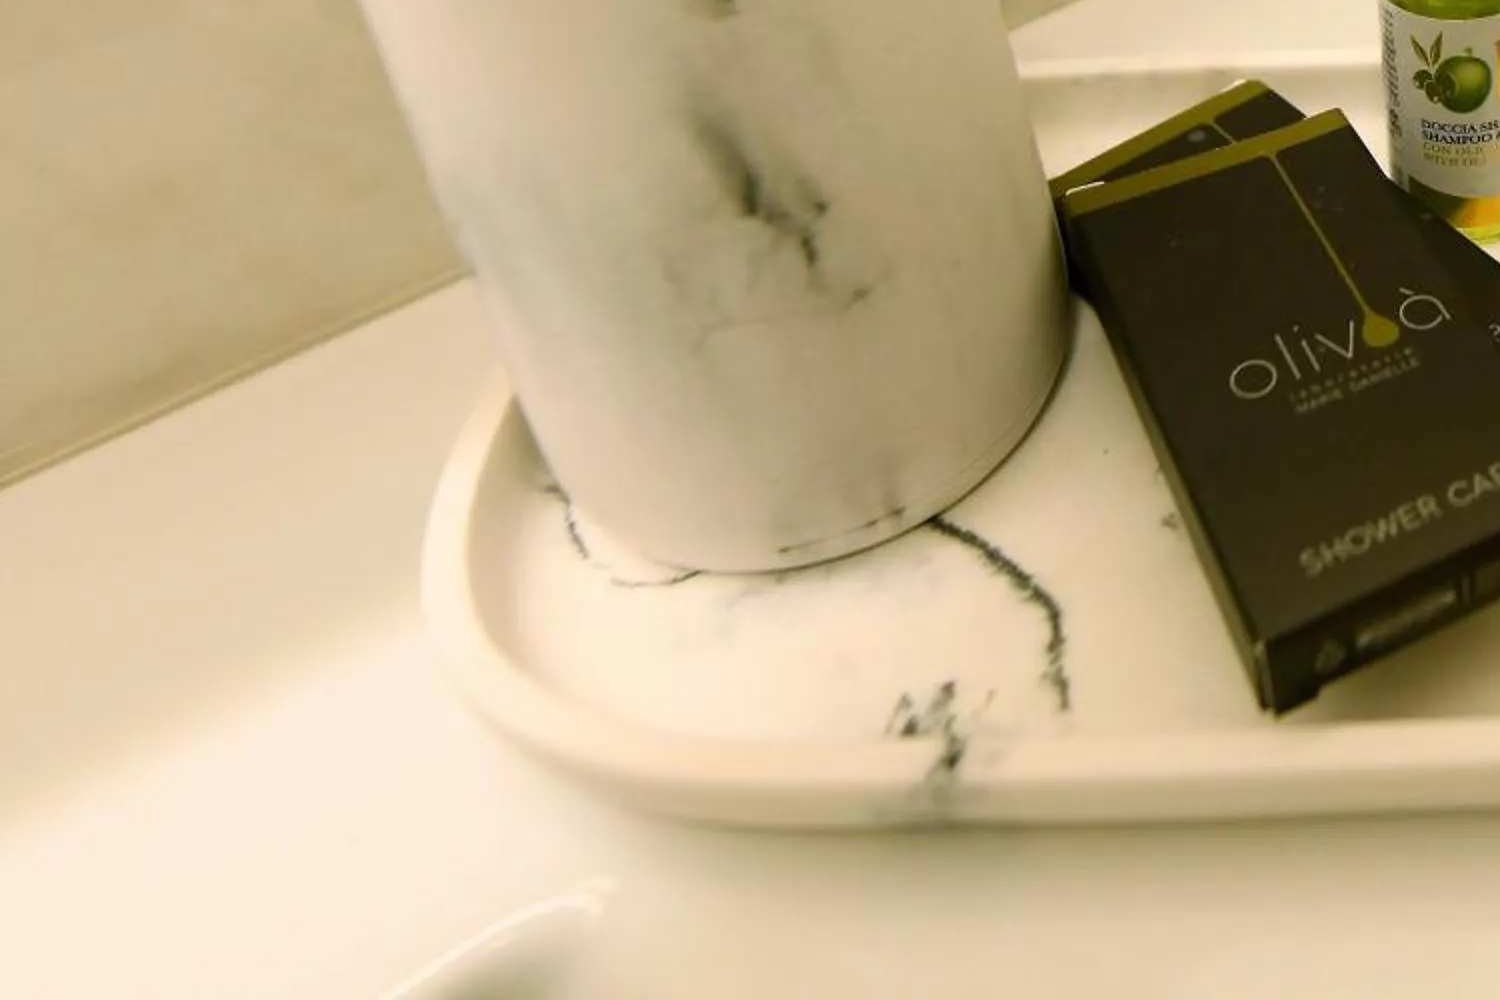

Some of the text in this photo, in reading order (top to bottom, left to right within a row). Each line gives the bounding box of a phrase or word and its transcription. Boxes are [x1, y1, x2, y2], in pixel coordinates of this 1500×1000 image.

[1420, 117, 1478, 134] DOCCIA
[1421, 129, 1493, 145] SHAMPOO
[1300, 495, 1441, 578] SHOWER
